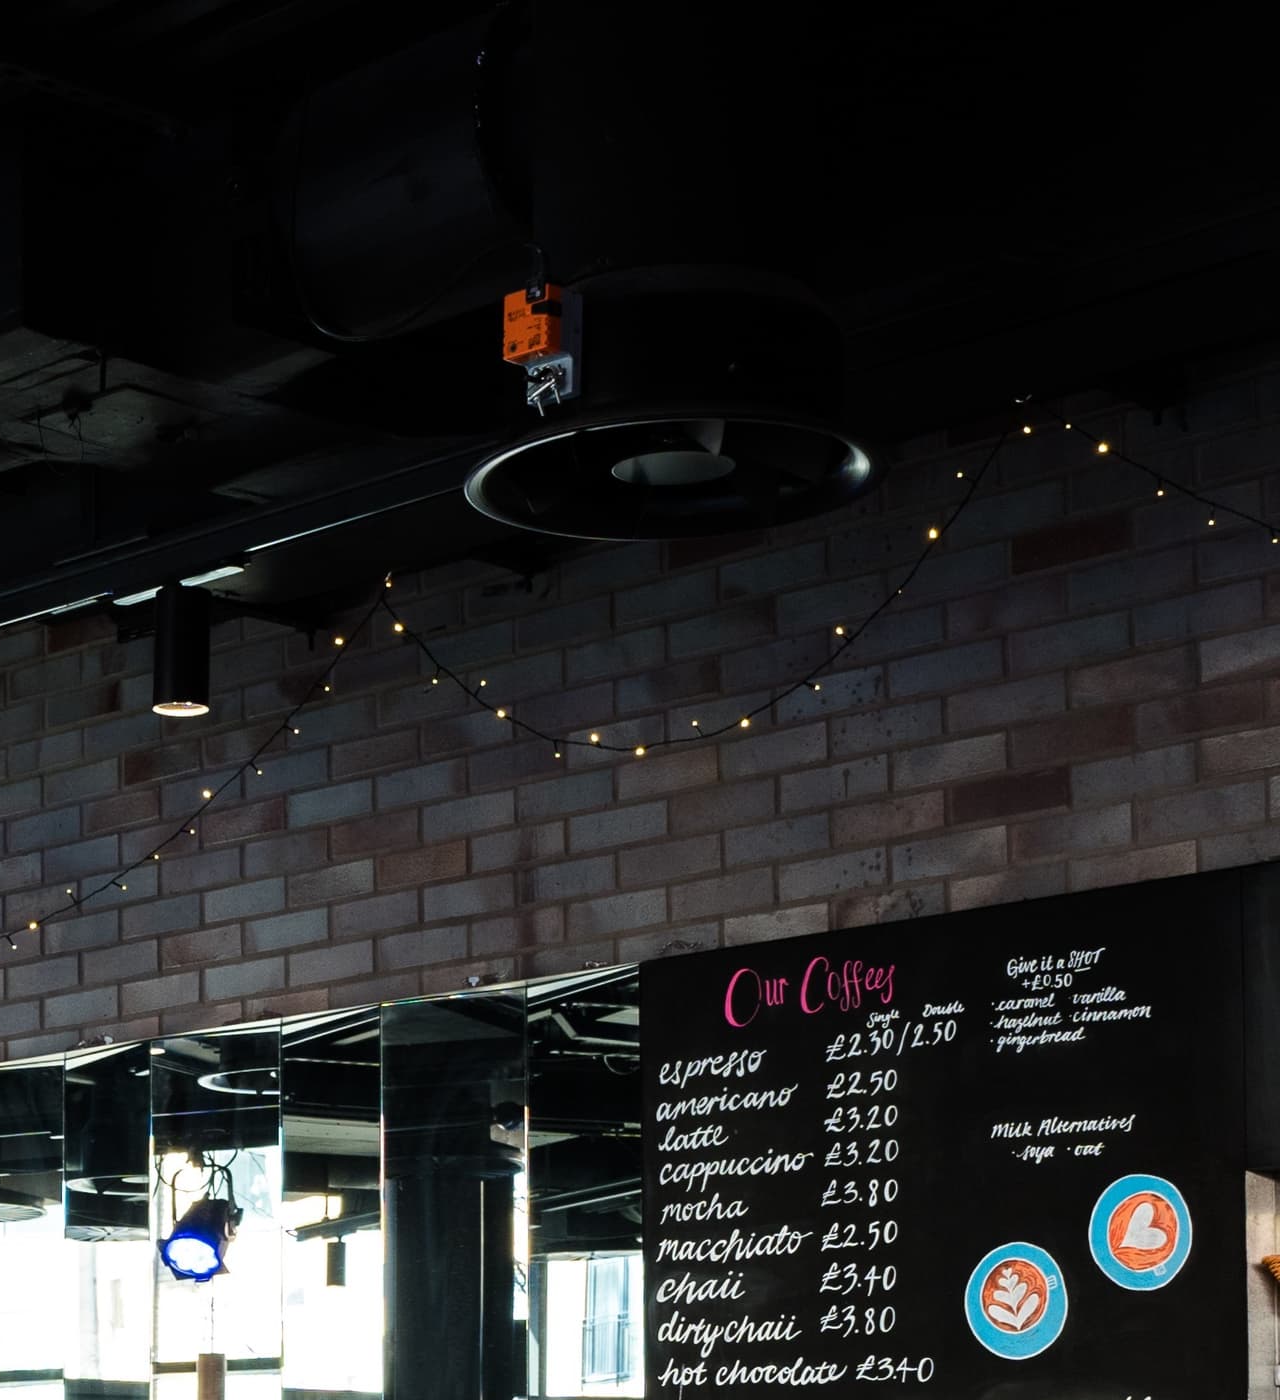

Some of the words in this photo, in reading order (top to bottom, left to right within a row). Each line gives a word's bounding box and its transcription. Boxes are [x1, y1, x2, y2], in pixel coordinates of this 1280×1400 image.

[1006, 956, 1038, 978] Give
[1040, 955, 1053, 971] it
[1056, 958, 1065, 970] a
[1067, 947, 1106, 971] SHOT
[724, 967, 789, 1028] Our
[800, 956, 896, 1014] Coffees
[1021, 973, 1073, 991] +£0.50
[866, 1008, 900, 1029] Single
[922, 1001, 965, 1019] Double
[995, 992, 1056, 1012] caramel
[1072, 986, 1127, 1004] vanilla
[993, 1011, 1063, 1033] hazelnut
[1072, 1005, 1152, 1023] cinnamon
[996, 1026, 1086, 1053] gingerbread
[658, 1049, 768, 1089] espresso
[656, 1083, 799, 1122] americano
[826, 1069, 898, 1099] £2.50
[658, 1124, 730, 1152] latte
[824, 1104, 898, 1133] £3.20
[990, 1121, 1033, 1139] Milk
[1037, 1114, 1137, 1137] Alternatives
[659, 1148, 815, 1193] cappuccino
[824, 1138, 899, 1168] £3.20
[1015, 1144, 1056, 1165] soya
[659, 1192, 750, 1225] mocha
[821, 1178, 899, 1208] £3.80
[656, 1224, 814, 1264] macchiato
[821, 1220, 899, 1252] £2.50
[656, 1269, 746, 1305] chaii
[819, 1262, 897, 1297] £3.40
[820, 1304, 896, 1338] £3.80
[658, 1356, 708, 1387] hot
[715, 1356, 848, 1386] chocolate
[855, 1354, 935, 1383] £3.40
